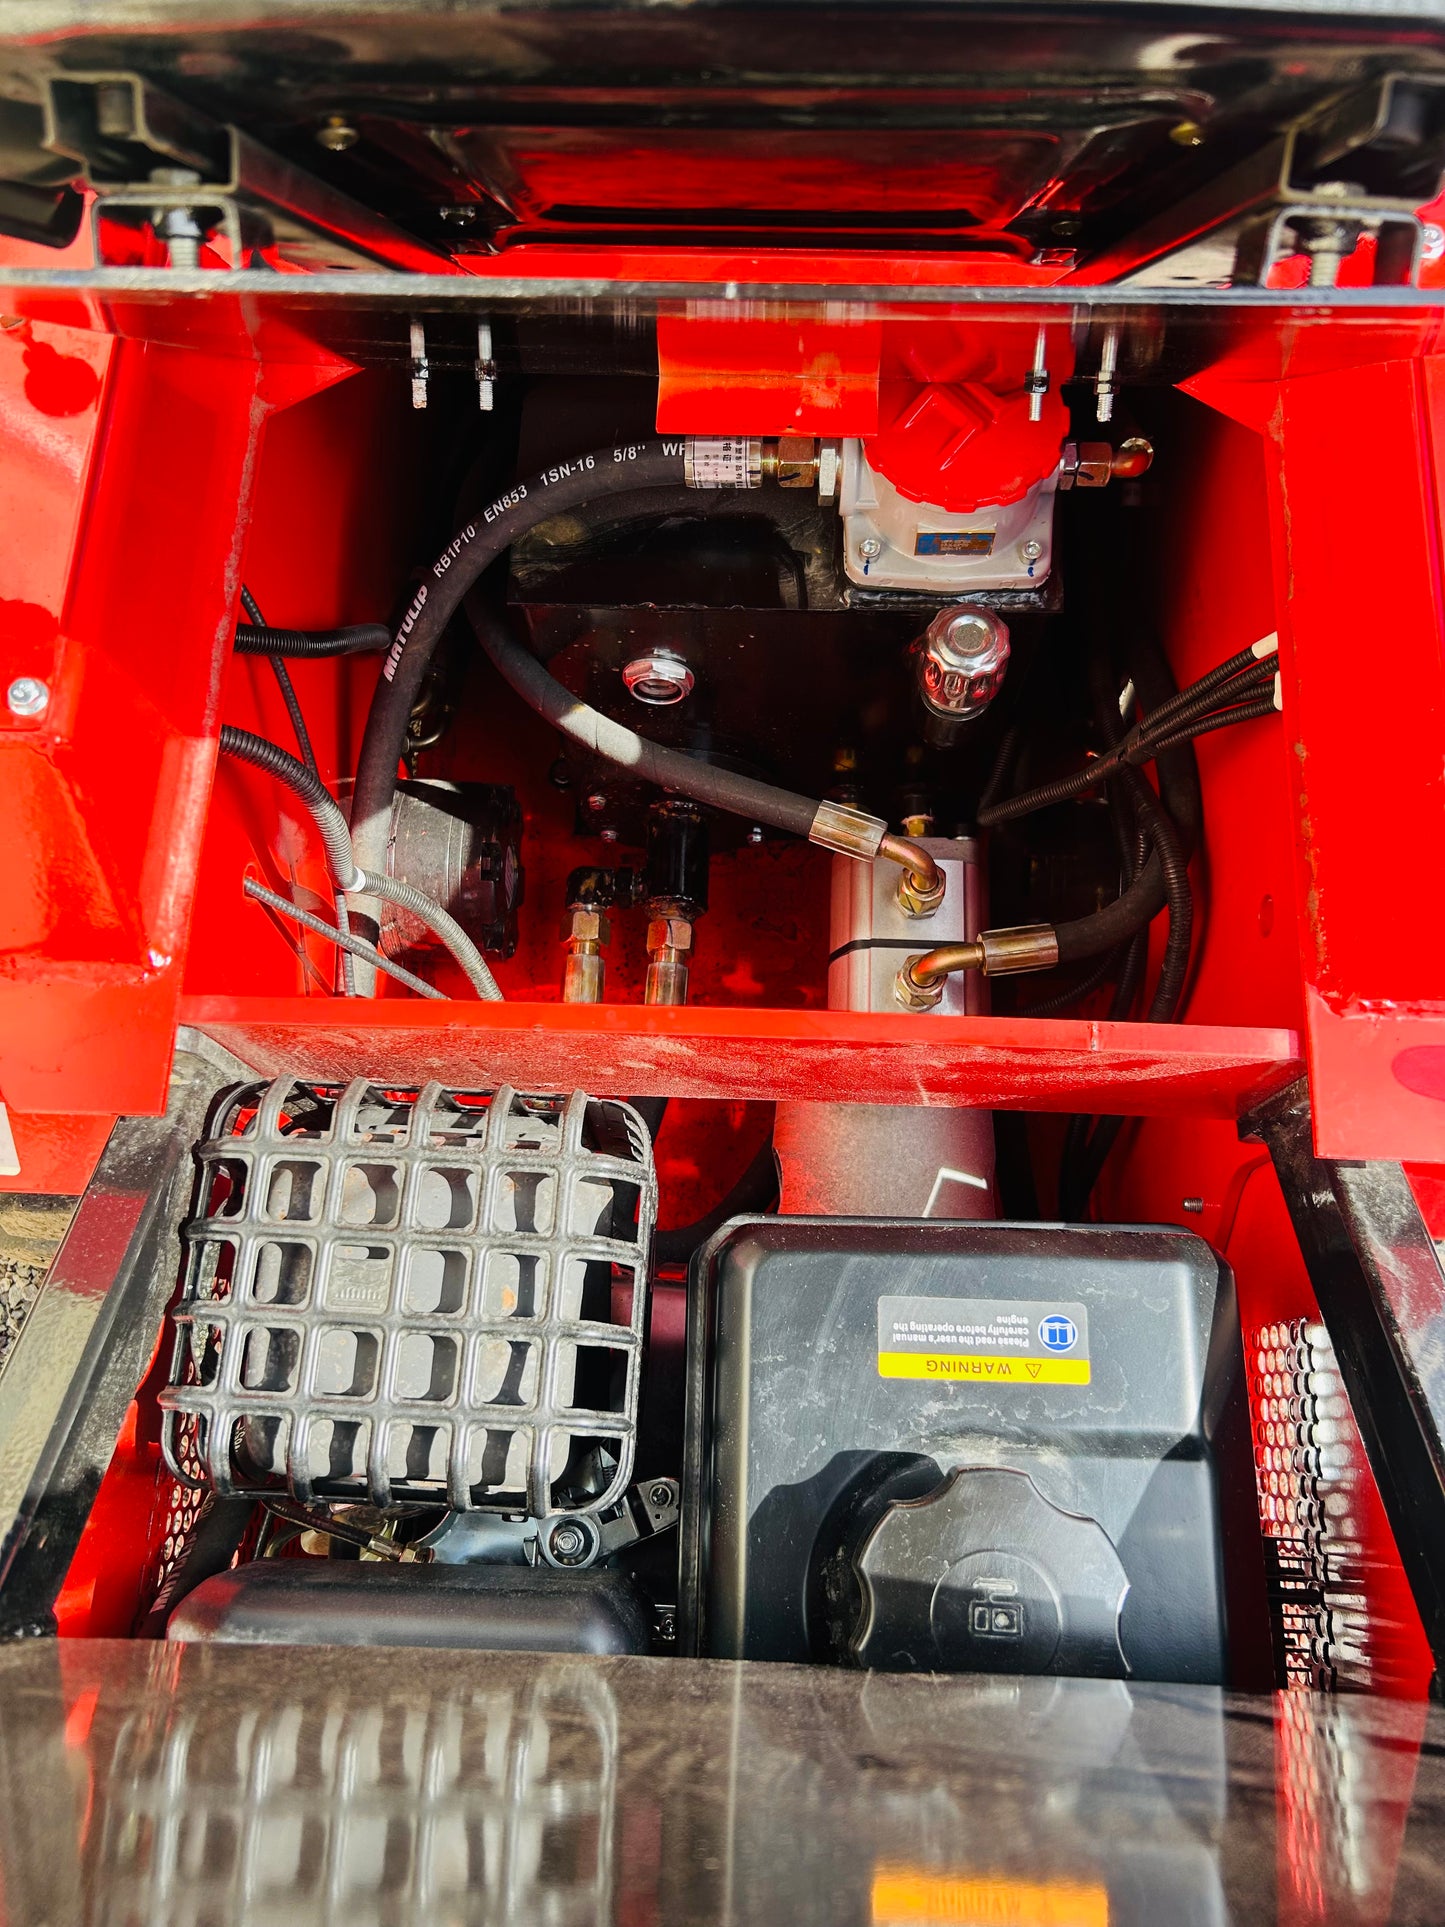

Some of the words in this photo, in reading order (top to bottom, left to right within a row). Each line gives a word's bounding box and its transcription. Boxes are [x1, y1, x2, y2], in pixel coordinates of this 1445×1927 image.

[383, 584, 428, 683] MATULIP
[433, 525, 476, 578] RB1P10
[483, 485, 528, 523] EN853
[540, 456, 595, 486] 1SN-16
[996, 1315, 1029, 1325] engine
[893, 1322, 908, 1332] the
[910, 1321, 953, 1333] operating
[956, 1324, 987, 1335] before
[988, 1324, 1029, 1336] carefully
[893, 1333, 927, 1343] manual
[928, 1334, 957, 1344] user's
[958, 1336, 974, 1346] the
[975, 1336, 997, 1346] read
[998, 1337, 1030, 1348] Please
[926, 1360, 1012, 1375] WARNING
